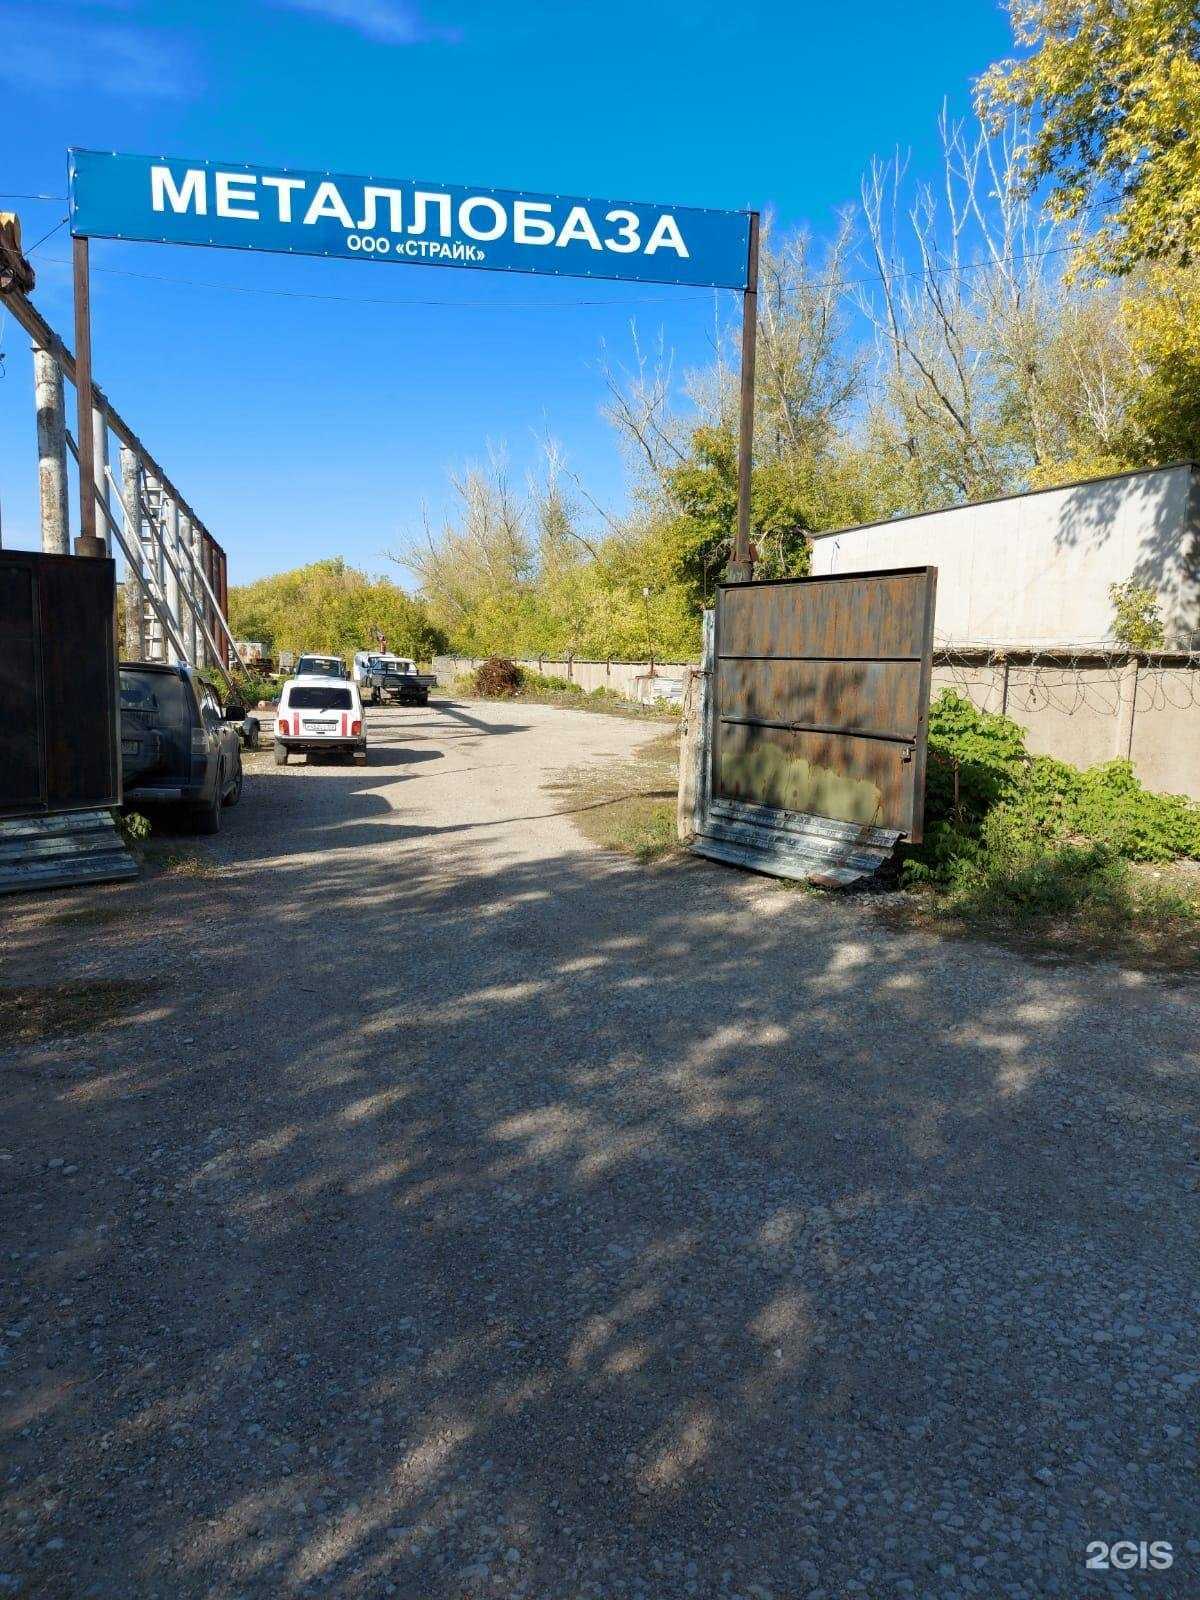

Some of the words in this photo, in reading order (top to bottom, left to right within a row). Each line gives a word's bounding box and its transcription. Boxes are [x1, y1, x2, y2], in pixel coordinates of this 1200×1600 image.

[150, 165, 691, 259] МЕТАЛЛОБАЗА
[346, 234, 391, 254] ООО
[395, 240, 486, 262] «СТРАЙК»
